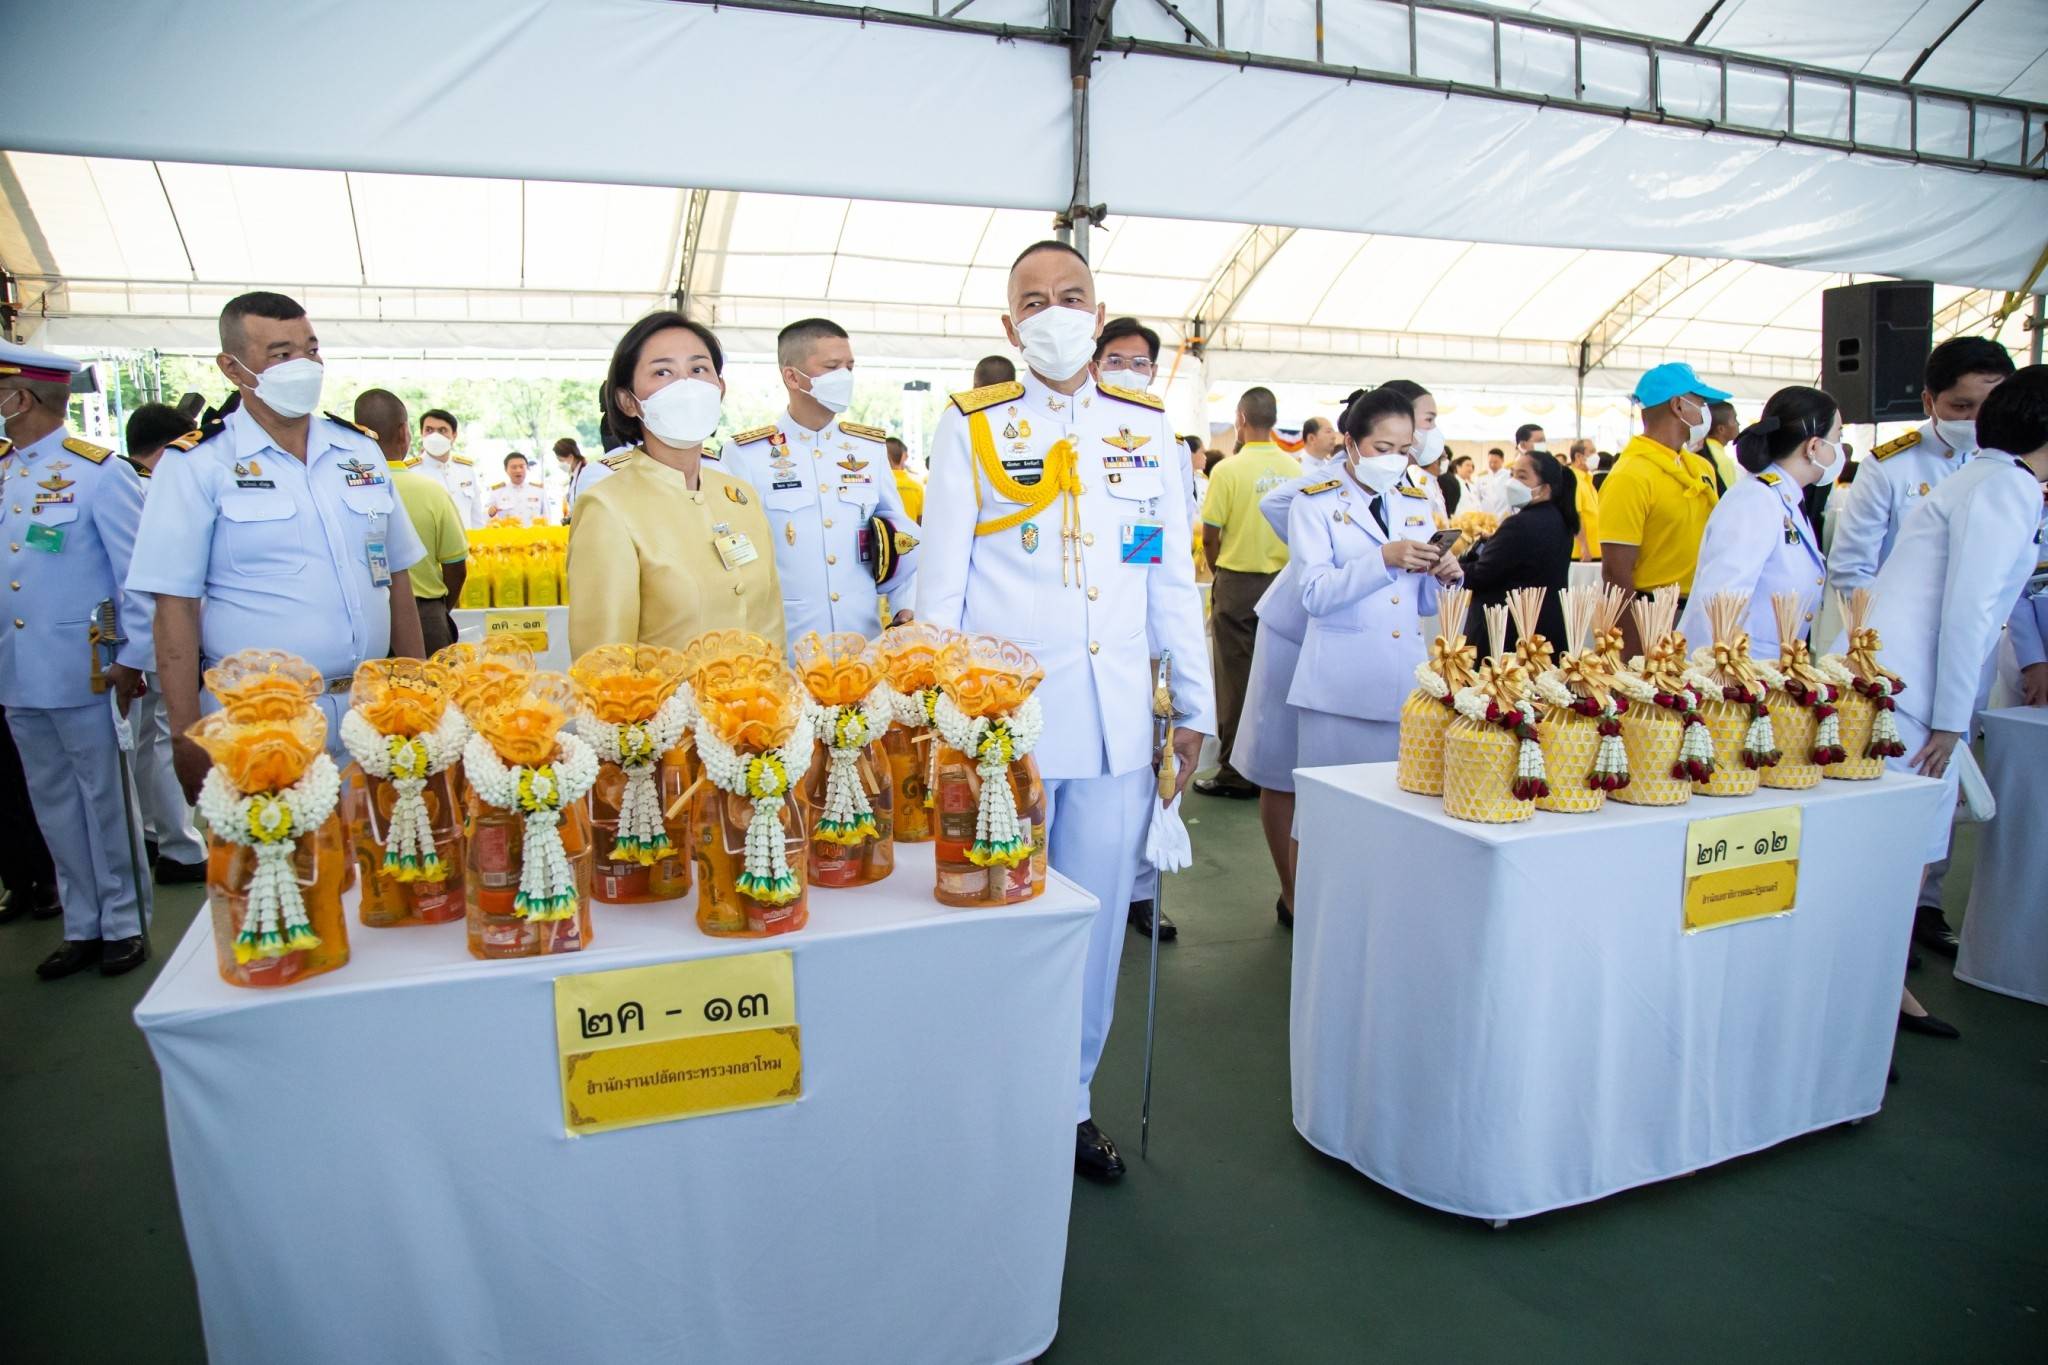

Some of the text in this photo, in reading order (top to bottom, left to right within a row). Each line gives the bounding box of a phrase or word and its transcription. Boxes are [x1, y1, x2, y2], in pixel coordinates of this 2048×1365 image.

[1697, 839, 1727, 865] ๒ค
[1755, 831, 1788, 855] ๑๒
[577, 1000, 645, 1039] ๒ค
[703, 991, 769, 1022] ๑๓
[586, 1054, 783, 1096] สำนักงานปลัดกระทรวงกลาโหม
